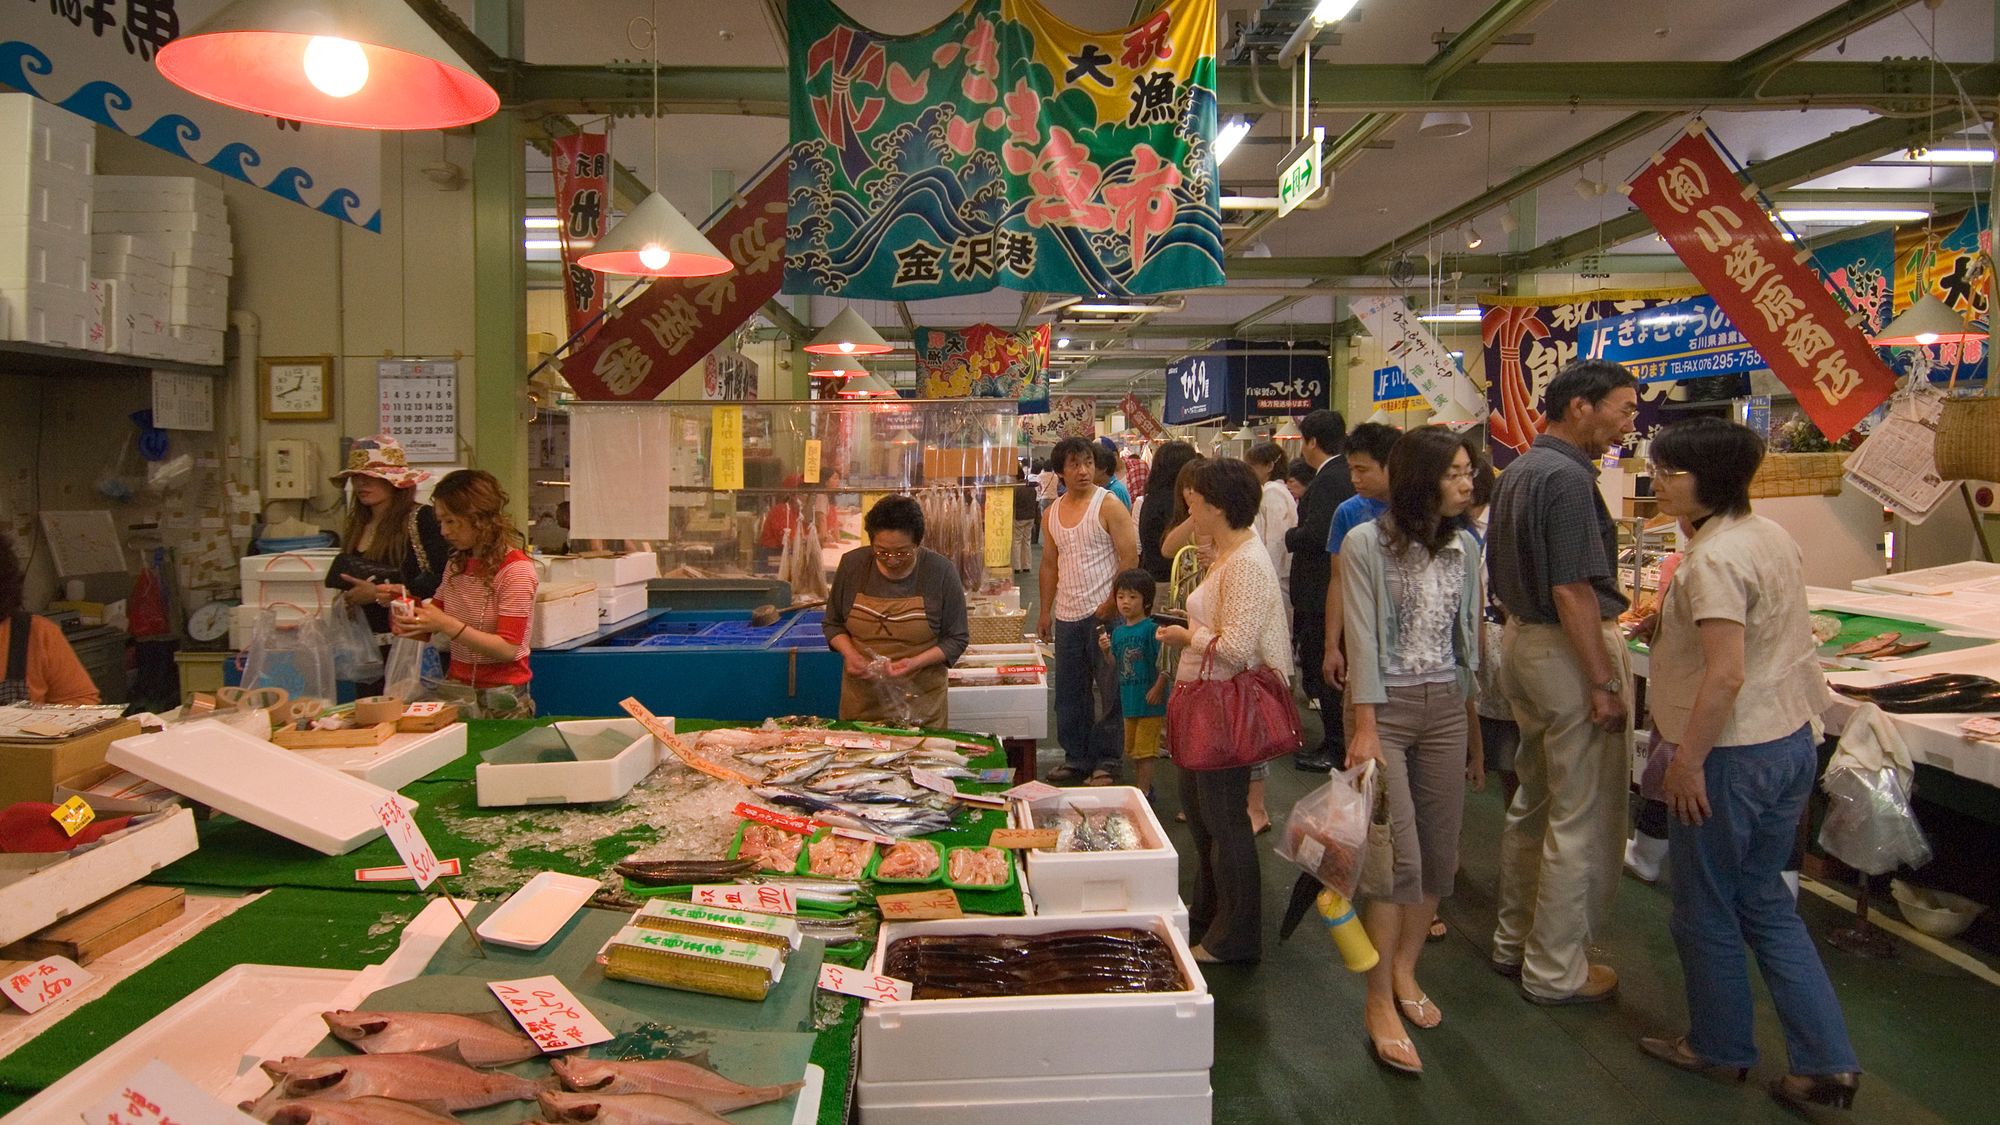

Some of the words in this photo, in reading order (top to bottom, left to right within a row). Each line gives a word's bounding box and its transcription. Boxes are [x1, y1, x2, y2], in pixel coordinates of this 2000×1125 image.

[1120, 10, 1173, 69] 祝
[1065, 45, 1177, 127] 大漁
[892, 229, 1038, 288] 金沢港
[1586, 326, 1614, 359] JF
[1712, 350, 1767, 370] 295-755
[1180, 359, 1206, 403] ひもの
[1377, 373, 1390, 396] JF
[410, 847, 436, 882] 500
[532, 990, 581, 1019] 250
